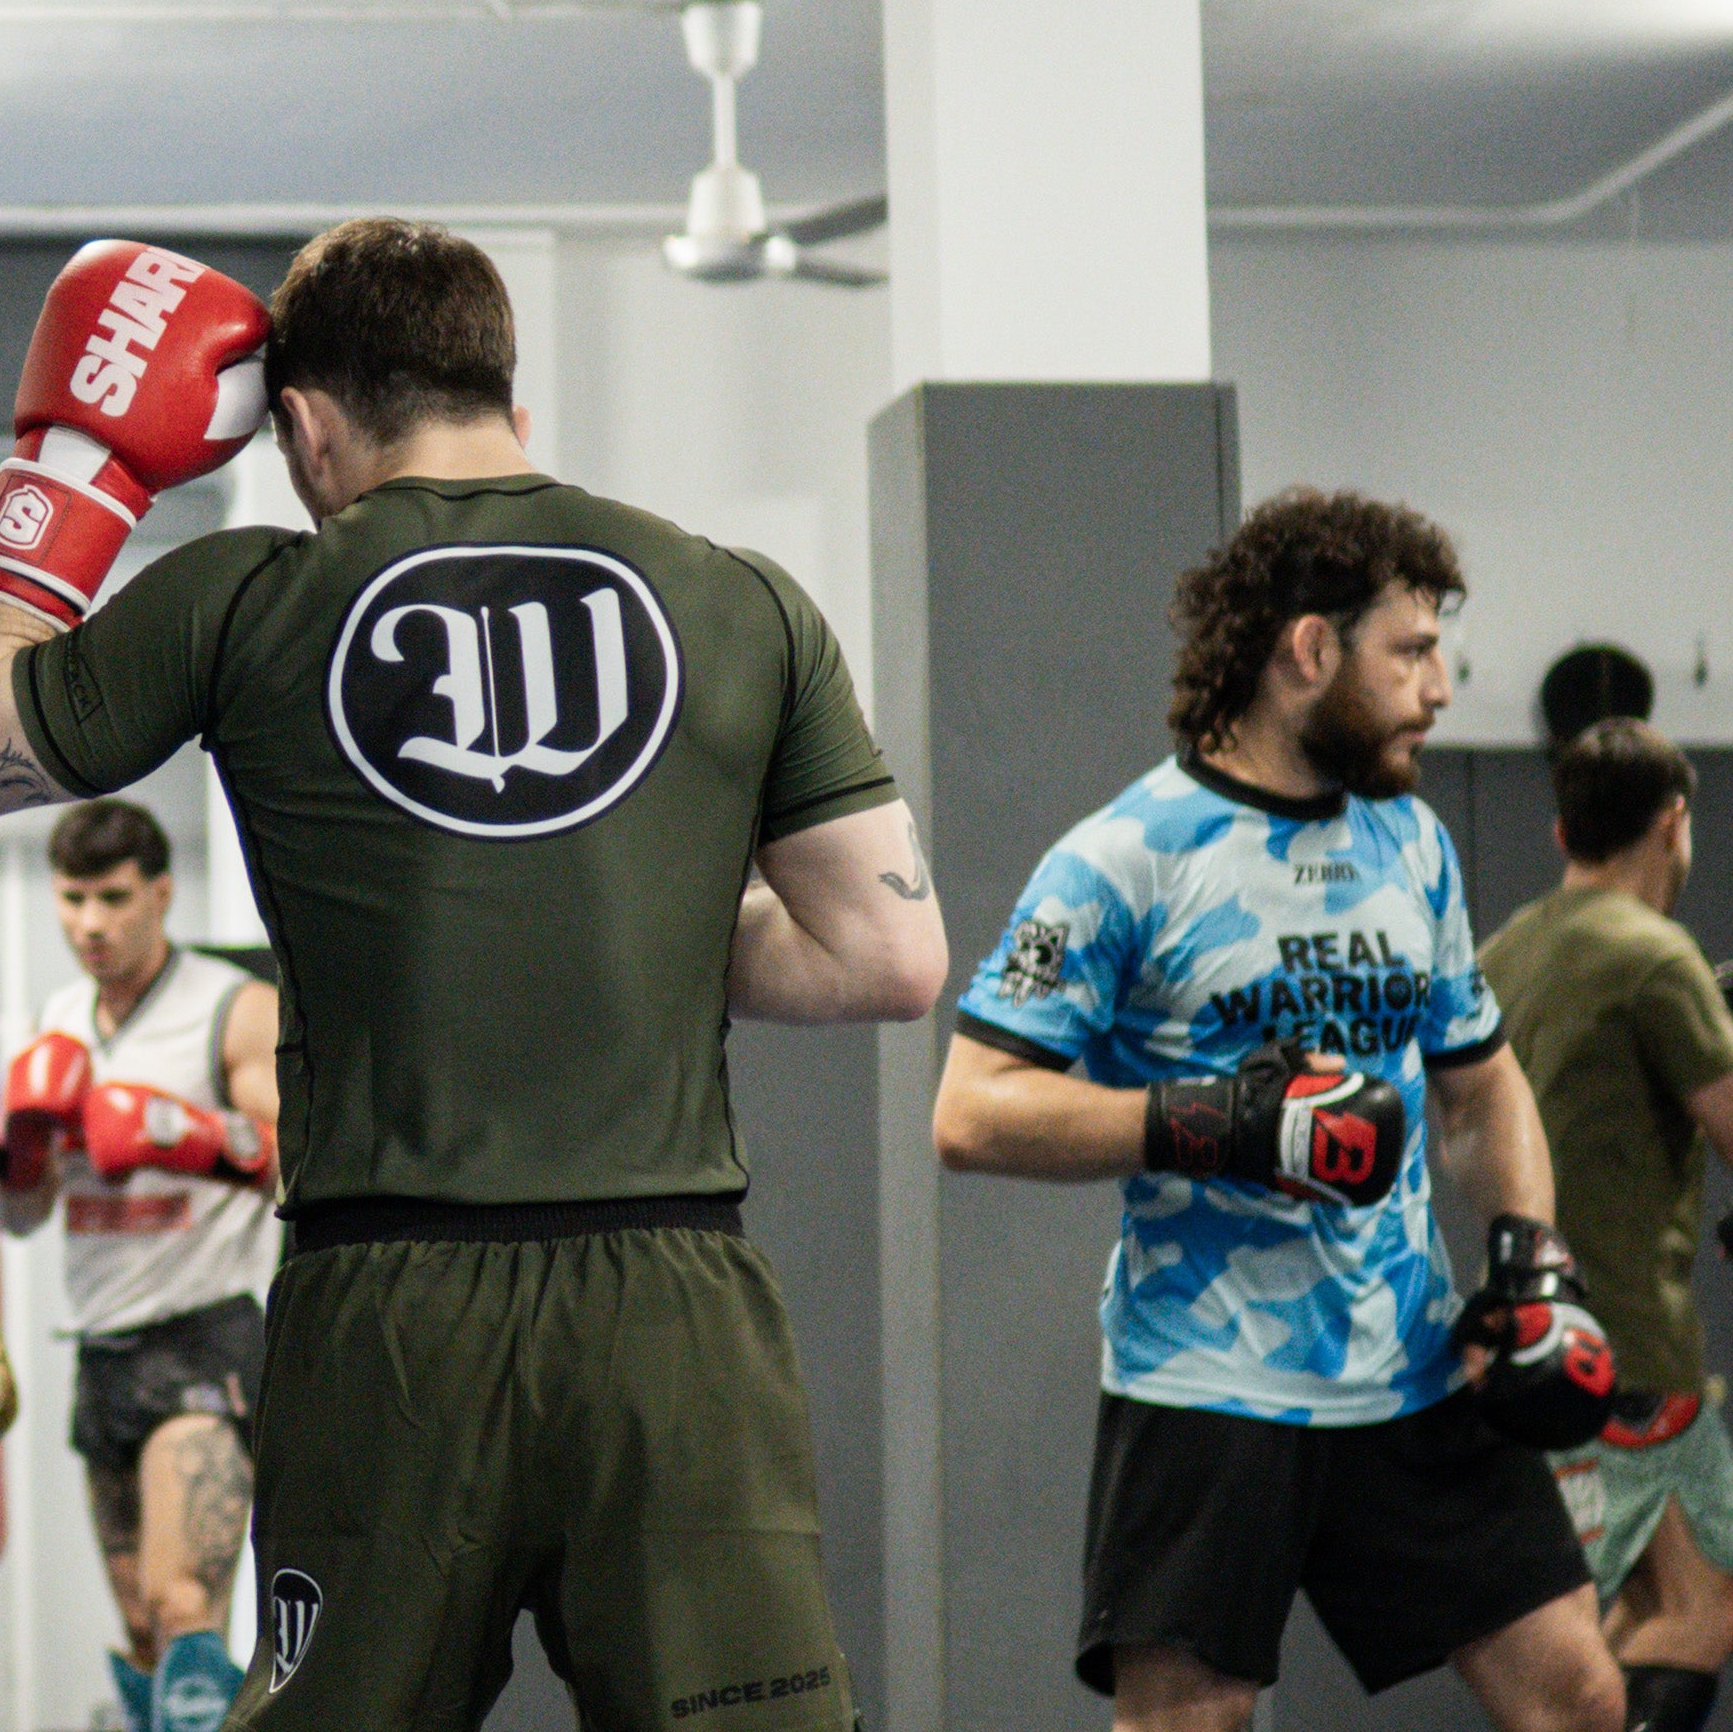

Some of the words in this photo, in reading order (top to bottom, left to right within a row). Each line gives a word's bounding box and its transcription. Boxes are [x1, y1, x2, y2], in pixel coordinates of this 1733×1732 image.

[70, 246, 210, 417] SHAR
[1278, 929, 1405, 973] REAL
[1209, 971, 1433, 1026] WARRIOR
[670, 1680, 767, 1719] SINCE
